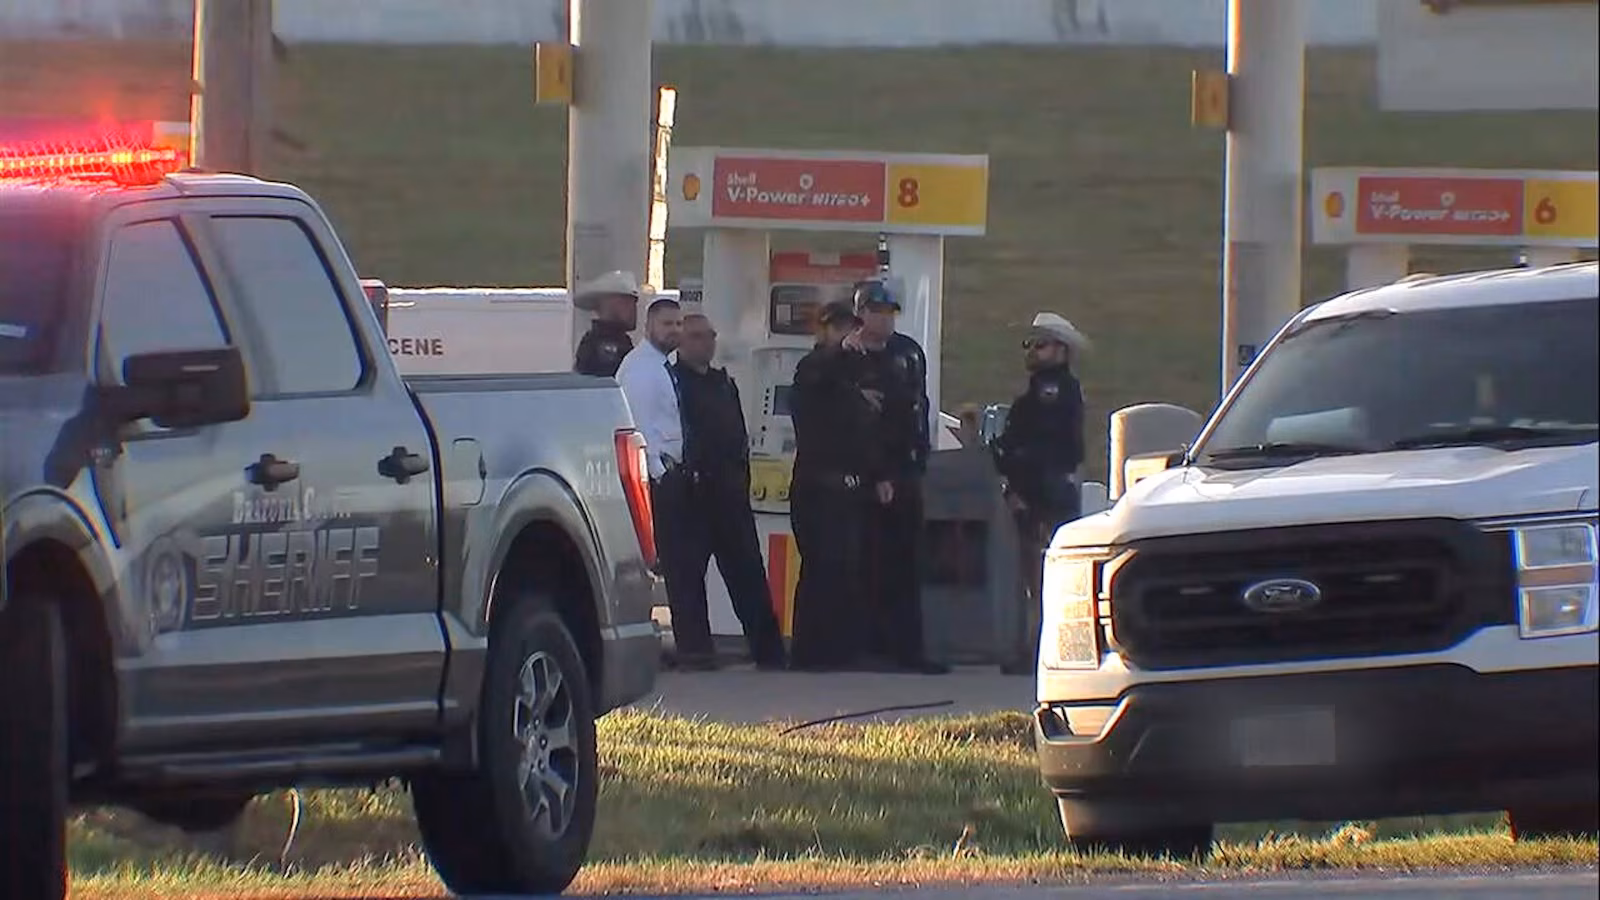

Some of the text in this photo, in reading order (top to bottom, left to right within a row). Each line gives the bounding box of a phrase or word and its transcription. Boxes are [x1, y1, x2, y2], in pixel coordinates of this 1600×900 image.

[726, 186, 806, 204] V-Power
[897, 177, 919, 208] 8
[1535, 197, 1557, 225] 6
[191, 526, 381, 622] SHERIFF
